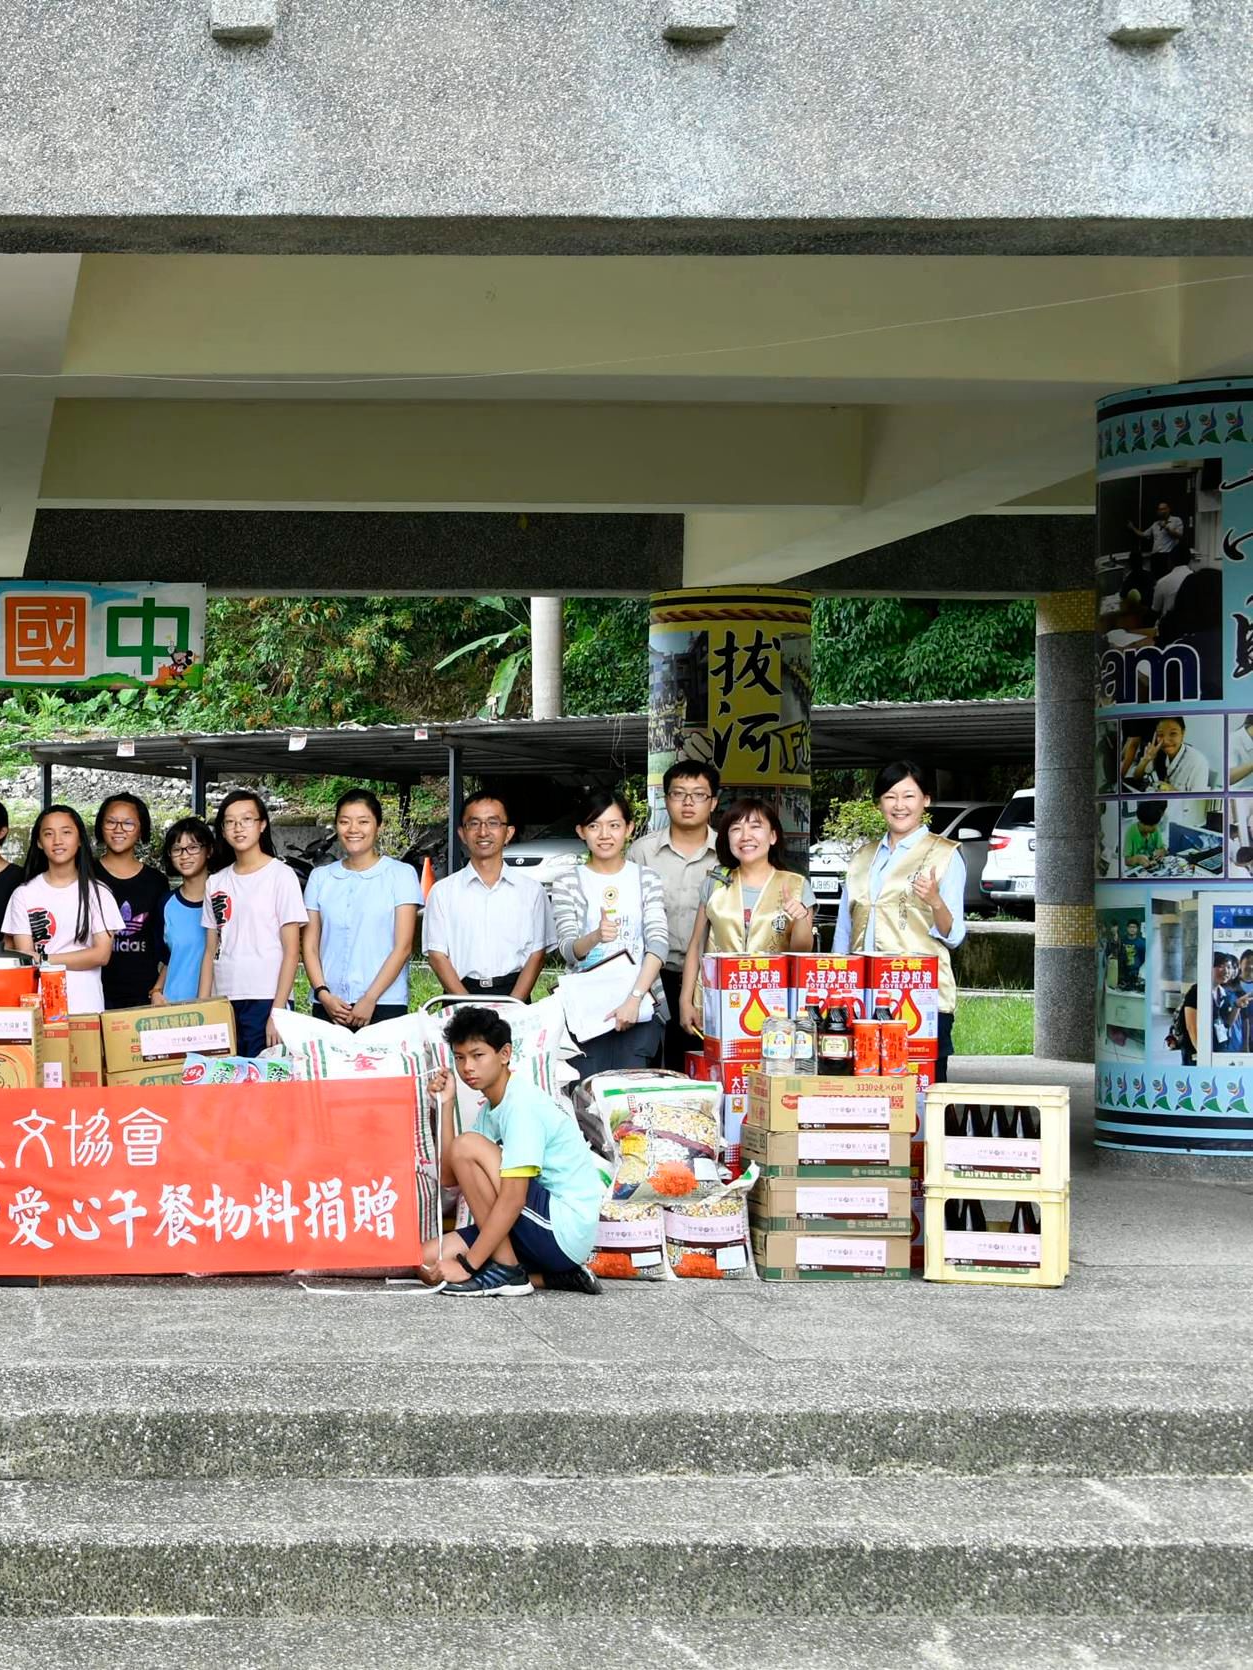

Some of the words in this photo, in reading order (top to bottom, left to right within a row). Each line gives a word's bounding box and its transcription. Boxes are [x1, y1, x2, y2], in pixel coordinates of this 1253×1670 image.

[710, 630, 783, 772] 拔河
[728, 970, 780, 984] 大豆沙拉油
[805, 970, 858, 984] 大豆沙拉油
[880, 970, 932, 984] 大豆沙拉油
